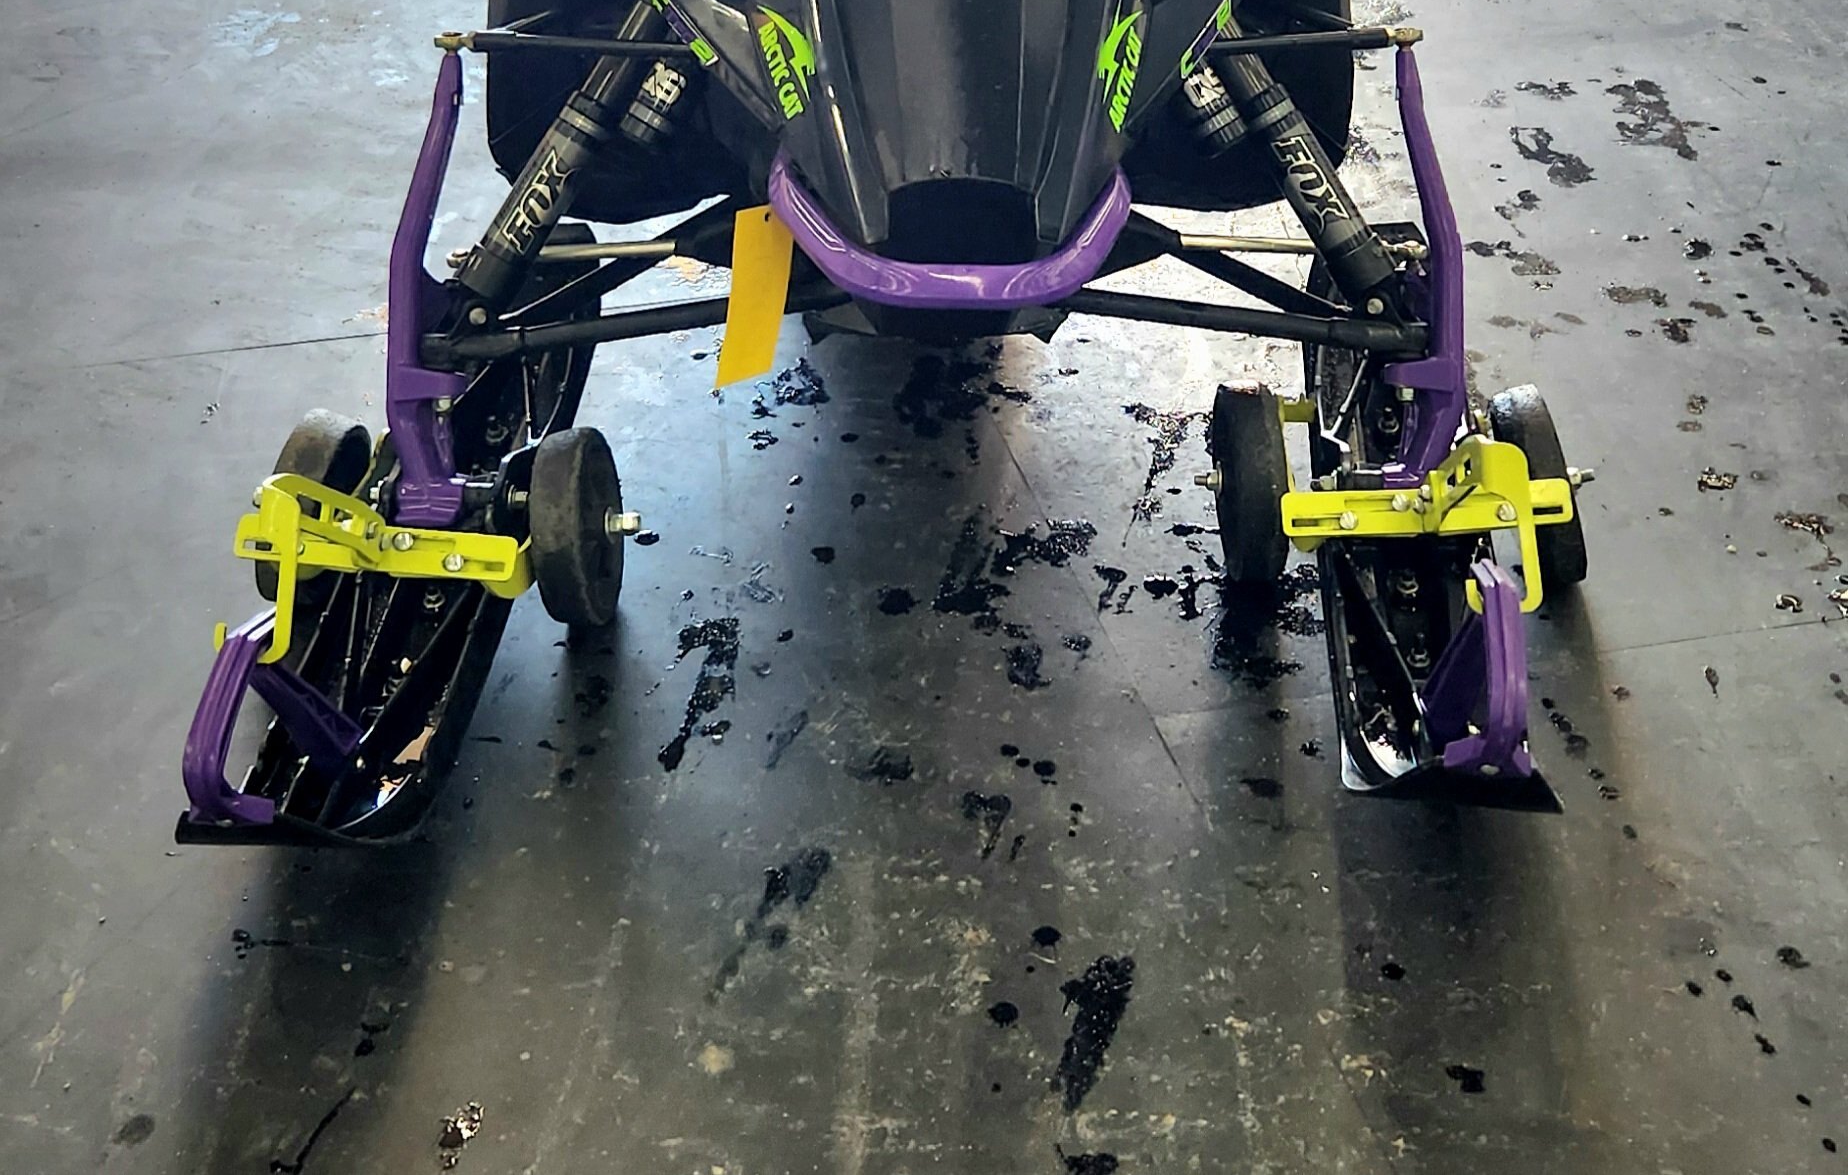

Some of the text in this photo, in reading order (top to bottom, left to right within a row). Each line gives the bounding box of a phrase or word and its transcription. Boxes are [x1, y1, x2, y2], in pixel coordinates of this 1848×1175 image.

[758, 20, 804, 120] ARCTIC CAT
[1108, 25, 1143, 134] ARCTIC CAT
[502, 148, 568, 256] FOX
[1271, 136, 1350, 230] FOX
